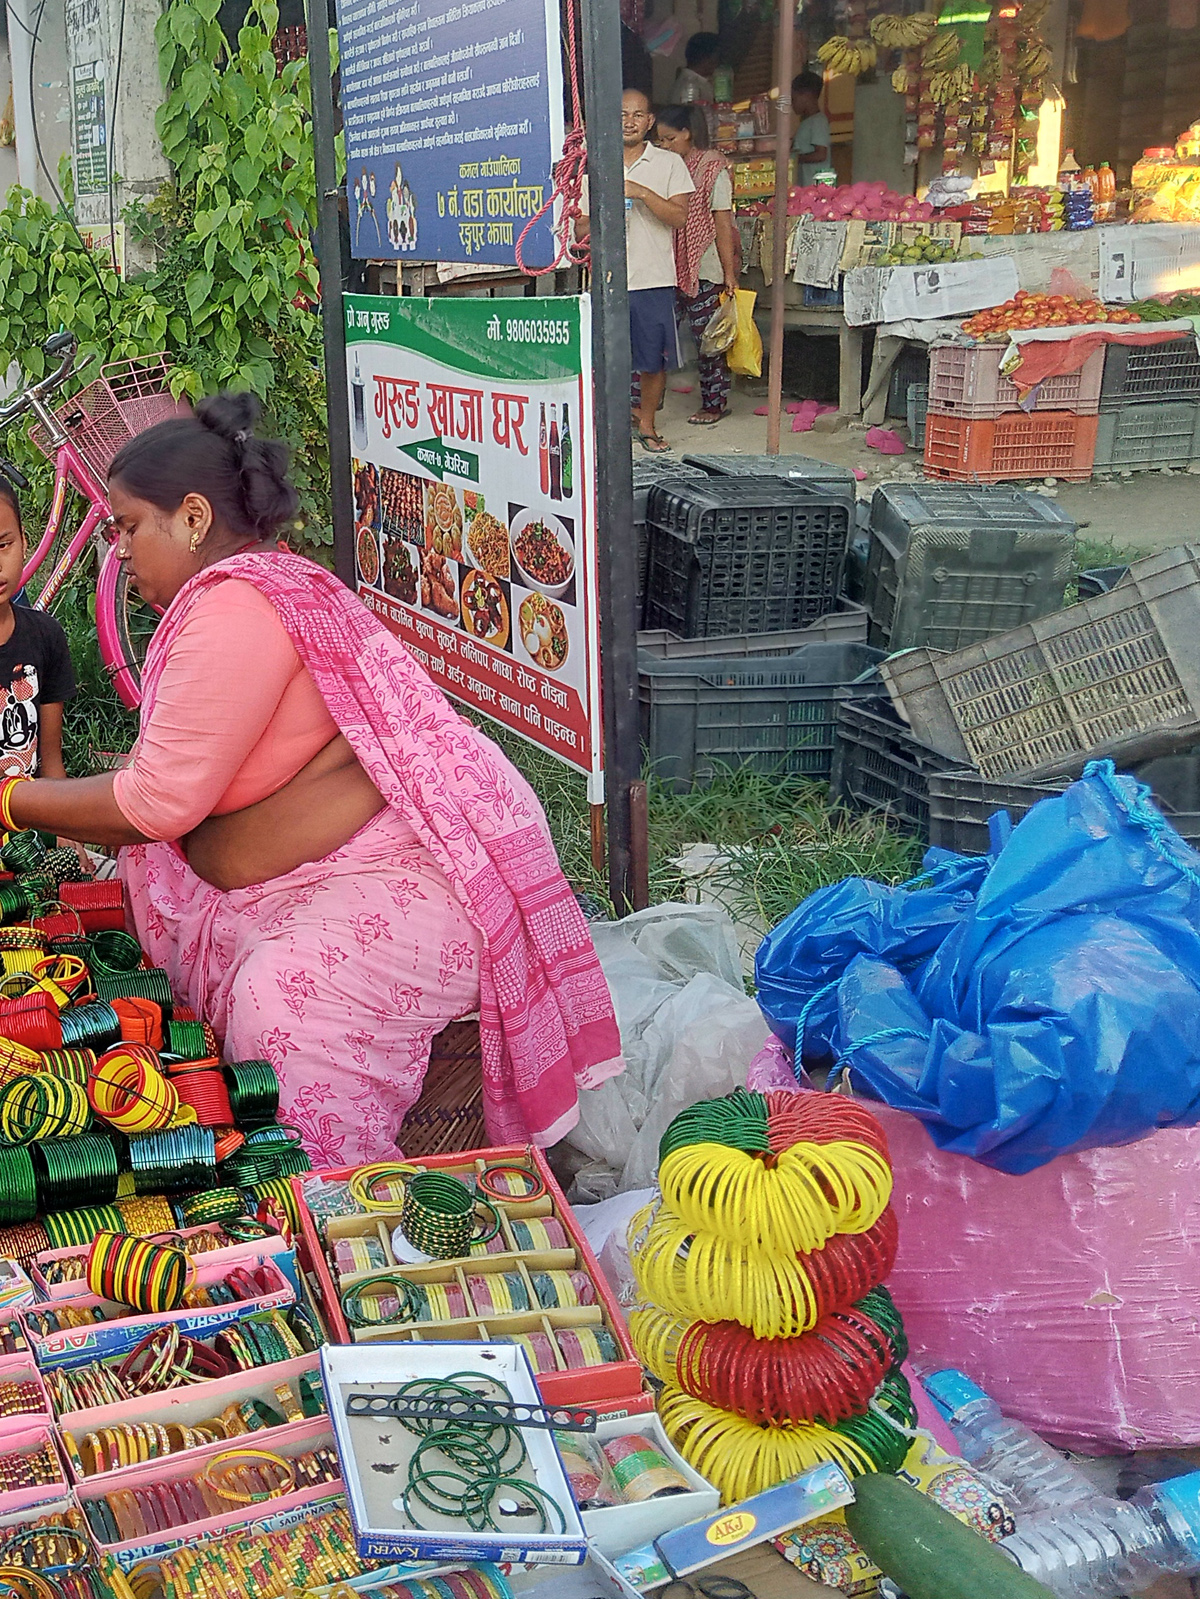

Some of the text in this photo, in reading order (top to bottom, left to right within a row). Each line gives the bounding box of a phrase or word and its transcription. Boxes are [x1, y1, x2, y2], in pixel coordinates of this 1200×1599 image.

[459, 163, 479, 178] कमल
[437, 191, 445, 218] ७
[463, 190, 483, 217] वडा
[486, 178, 544, 218] कार्यालय
[487, 223, 513, 246] झापा
[506, 319, 570, 345] 9806035955
[426, 383, 484, 443] खाजा
[491, 392, 529, 456] घर
[467, 675, 497, 706] अनुसार
[499, 691, 522, 718] खाना
[523, 703, 542, 729] पनि
[715, 1516, 743, 1540] AKJ
[367, 1544, 419, 1558] KAVERI
